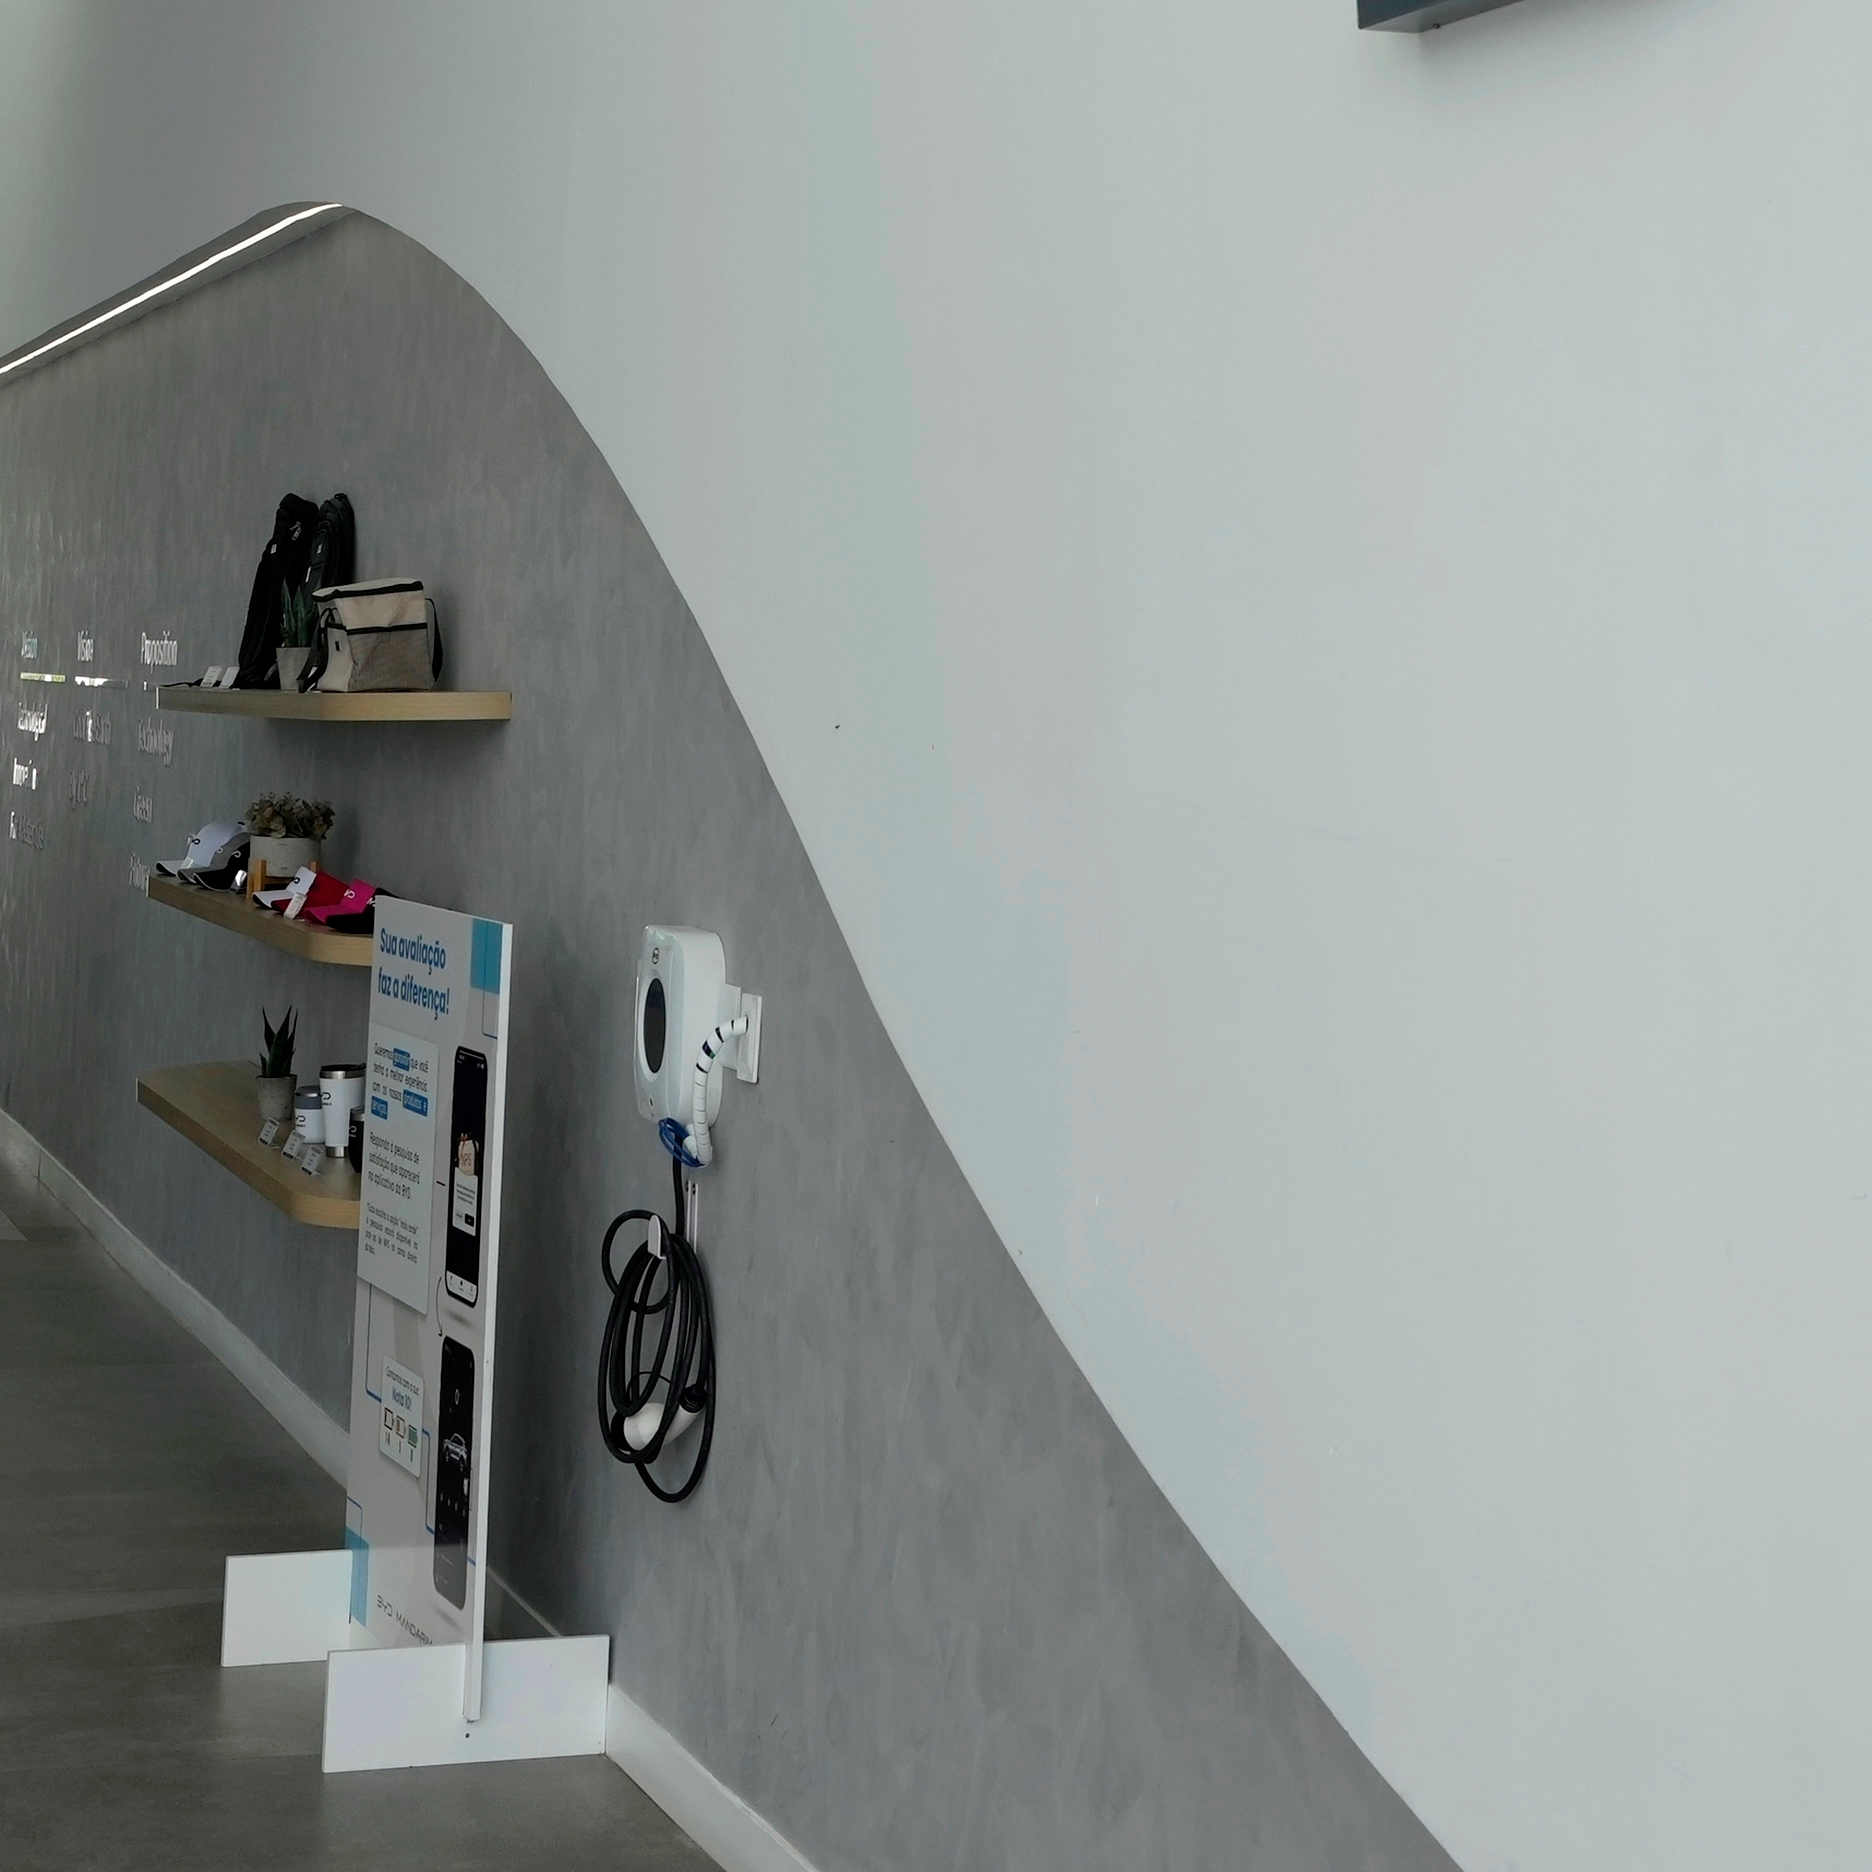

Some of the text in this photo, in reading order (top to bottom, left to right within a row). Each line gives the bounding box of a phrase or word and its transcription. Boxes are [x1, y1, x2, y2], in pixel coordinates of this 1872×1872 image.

[380, 927, 447, 976] Sua avaliação
[377, 967, 451, 1021] faz a diferença!
[377, 1594, 393, 1617] BYD
